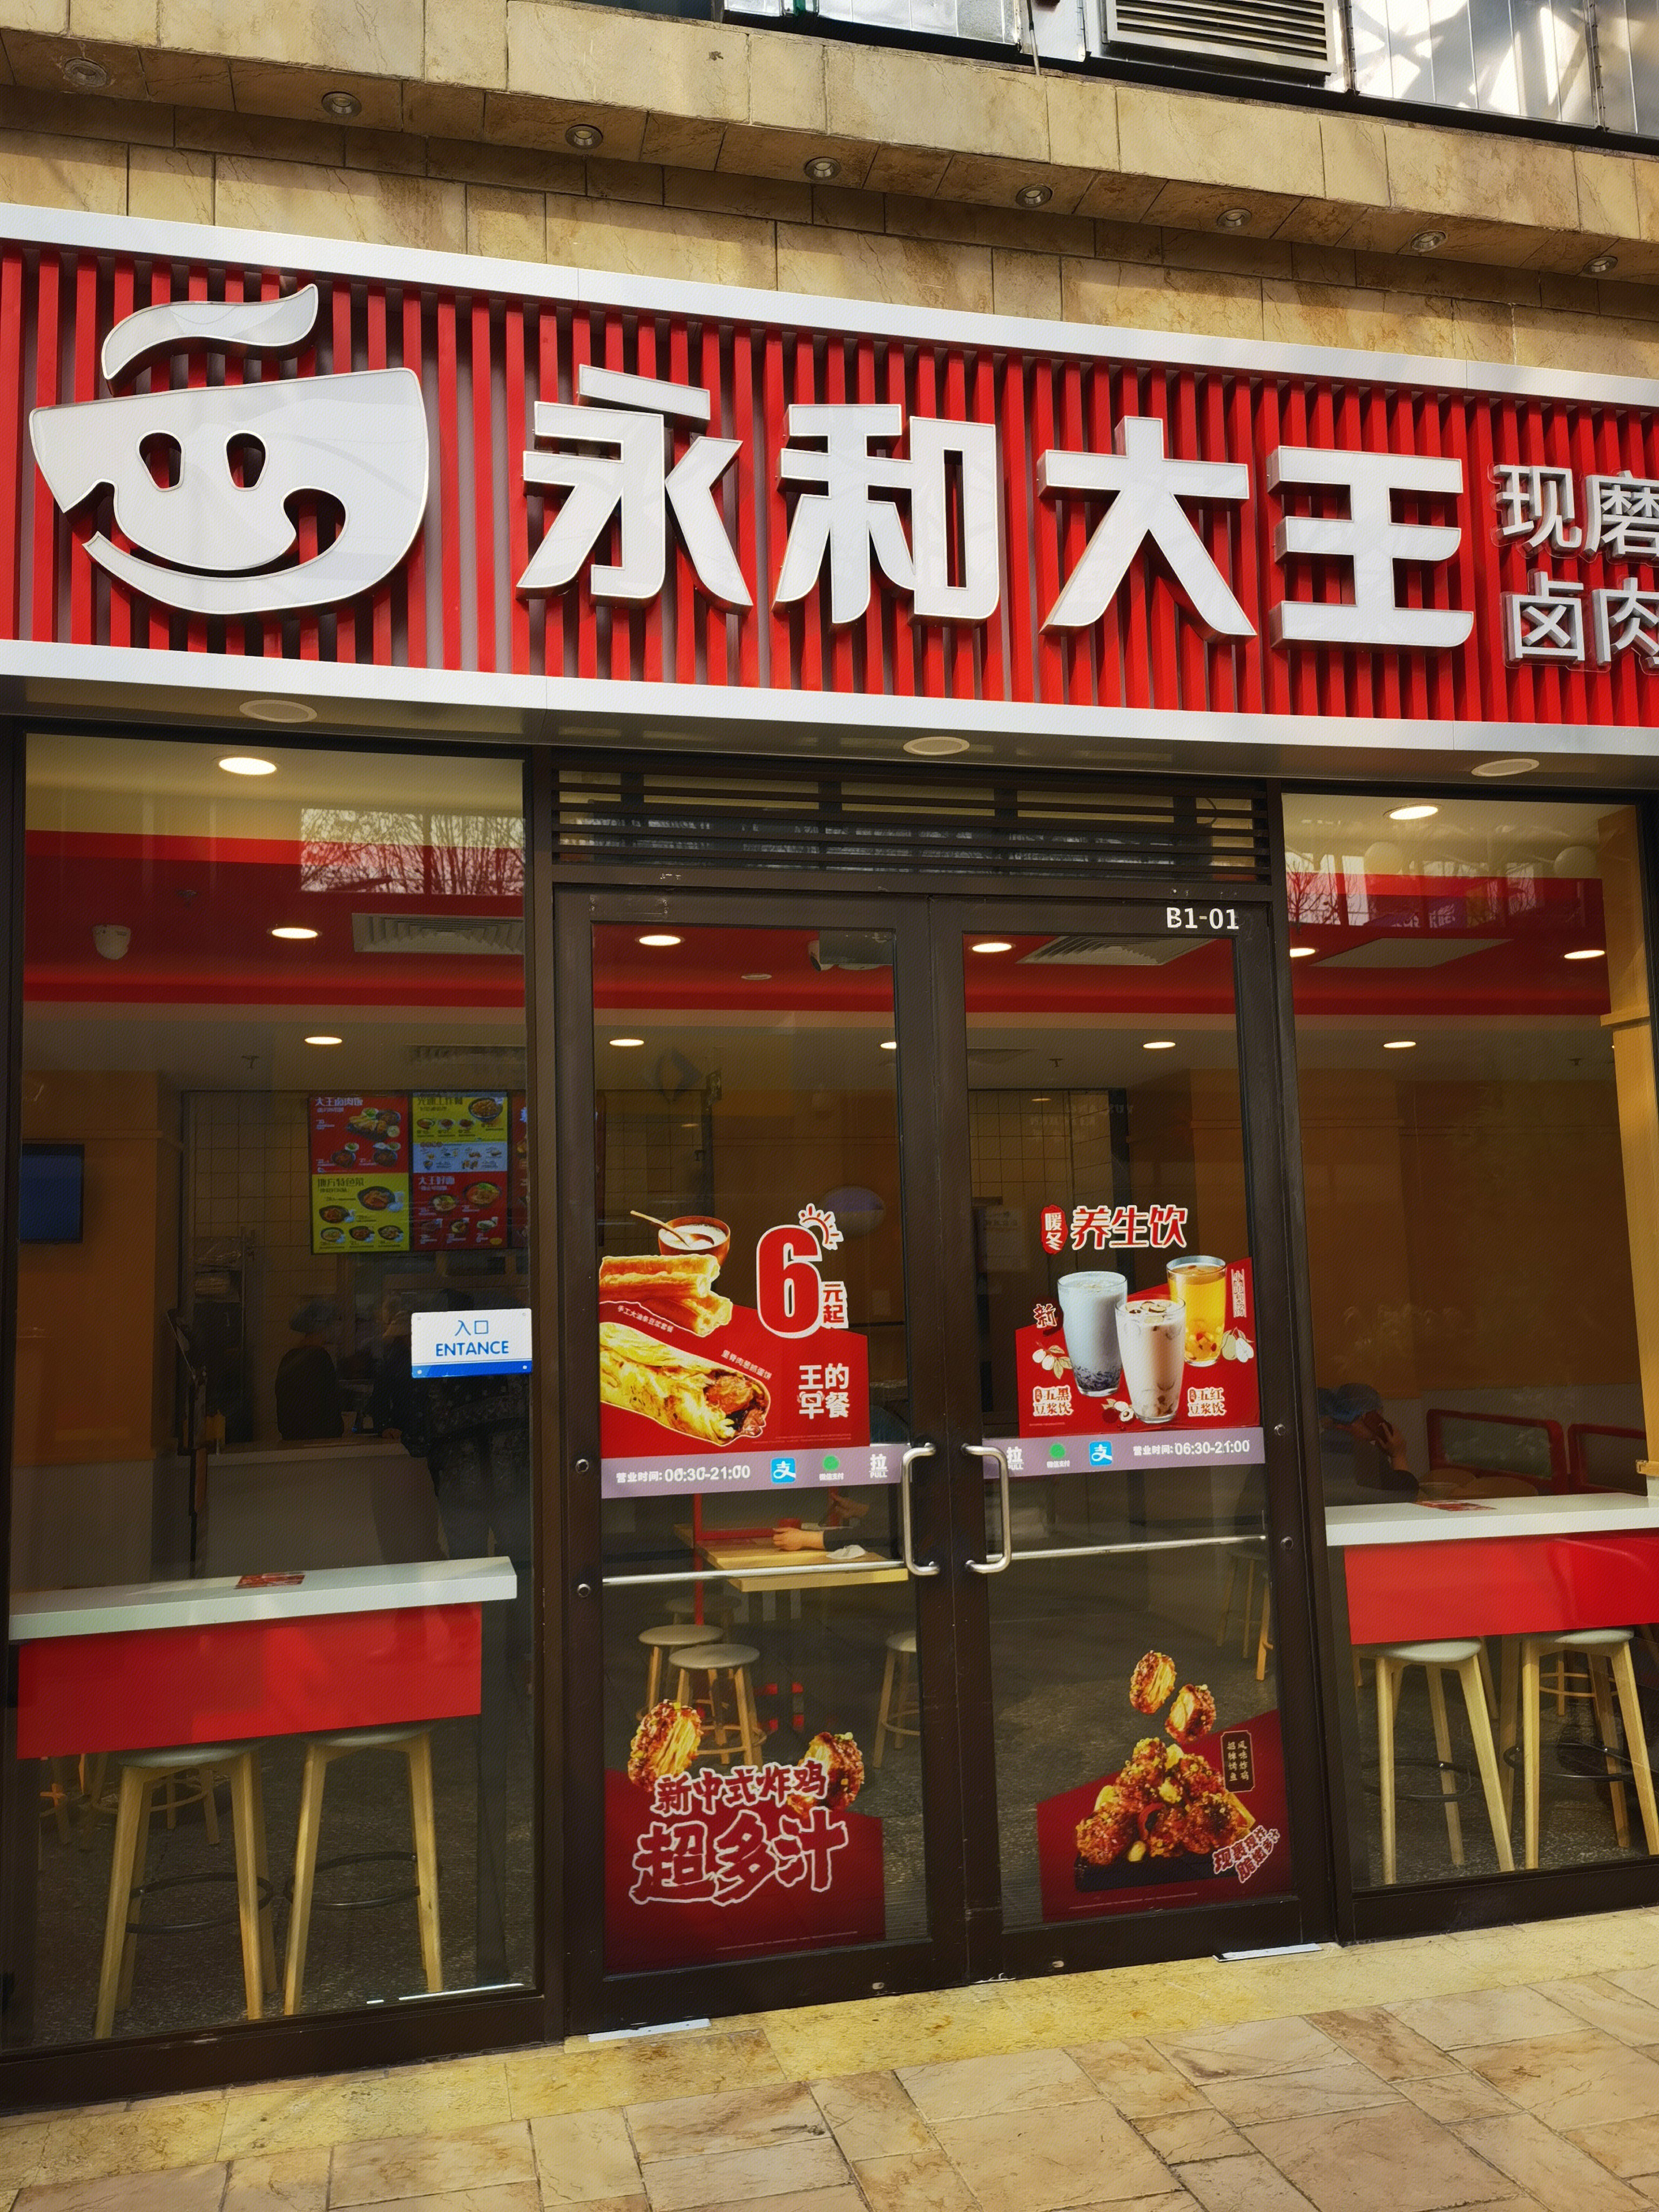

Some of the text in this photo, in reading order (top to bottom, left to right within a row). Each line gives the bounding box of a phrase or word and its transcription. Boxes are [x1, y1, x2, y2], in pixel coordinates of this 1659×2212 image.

[516, 363, 1474, 651] 永和大王
[1493, 464, 1659, 558] 现磨
[1506, 571, 1659, 666] 卤肉
[1166, 907, 1239, 929] B1-01
[1044, 1212, 1063, 1251] 暖冬
[1070, 1204, 1188, 1250] 养生饮
[757, 1224, 822, 1339] 6
[822, 1282, 846, 1326] 元起
[1033, 1304, 1057, 1328] 新
[455, 1320, 489, 1337] 入口
[436, 1341, 509, 1357] ENTANCE
[798, 1363, 849, 1390] 王的
[798, 1391, 850, 1419] 早餐
[870, 1453, 887, 1471] 拉
[1007, 1446, 1023, 1462] 拉
[650, 1757, 830, 1817] 新中式炸鸡
[629, 1806, 848, 1906] 超多汁
